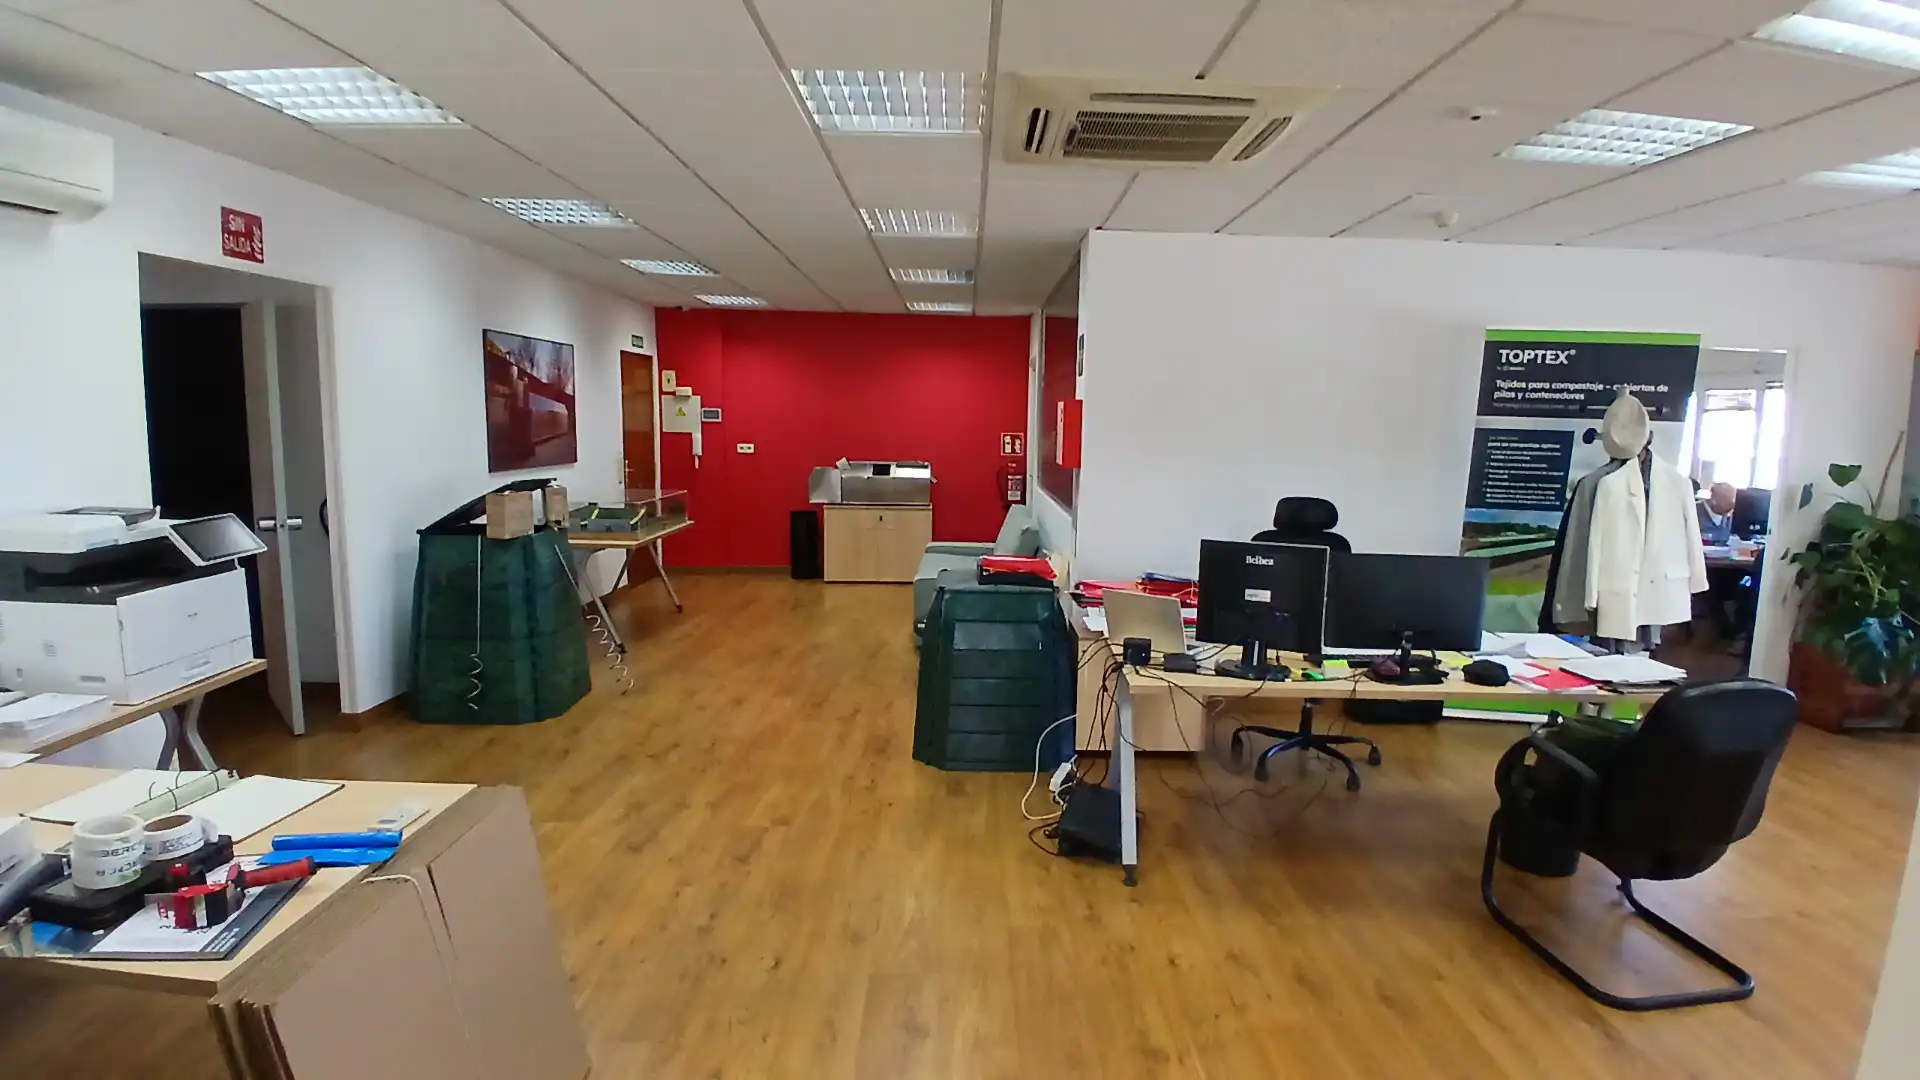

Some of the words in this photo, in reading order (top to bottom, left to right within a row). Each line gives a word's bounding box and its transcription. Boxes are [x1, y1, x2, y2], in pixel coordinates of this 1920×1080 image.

[1496, 380, 1526, 389] Tejidos
[1528, 382, 1550, 391] para
[1551, 382, 1604, 392] compostaje
[1656, 384, 1669, 393] de
[1493, 390, 1516, 400] pilas
[1525, 391, 1585, 401] contenedores
